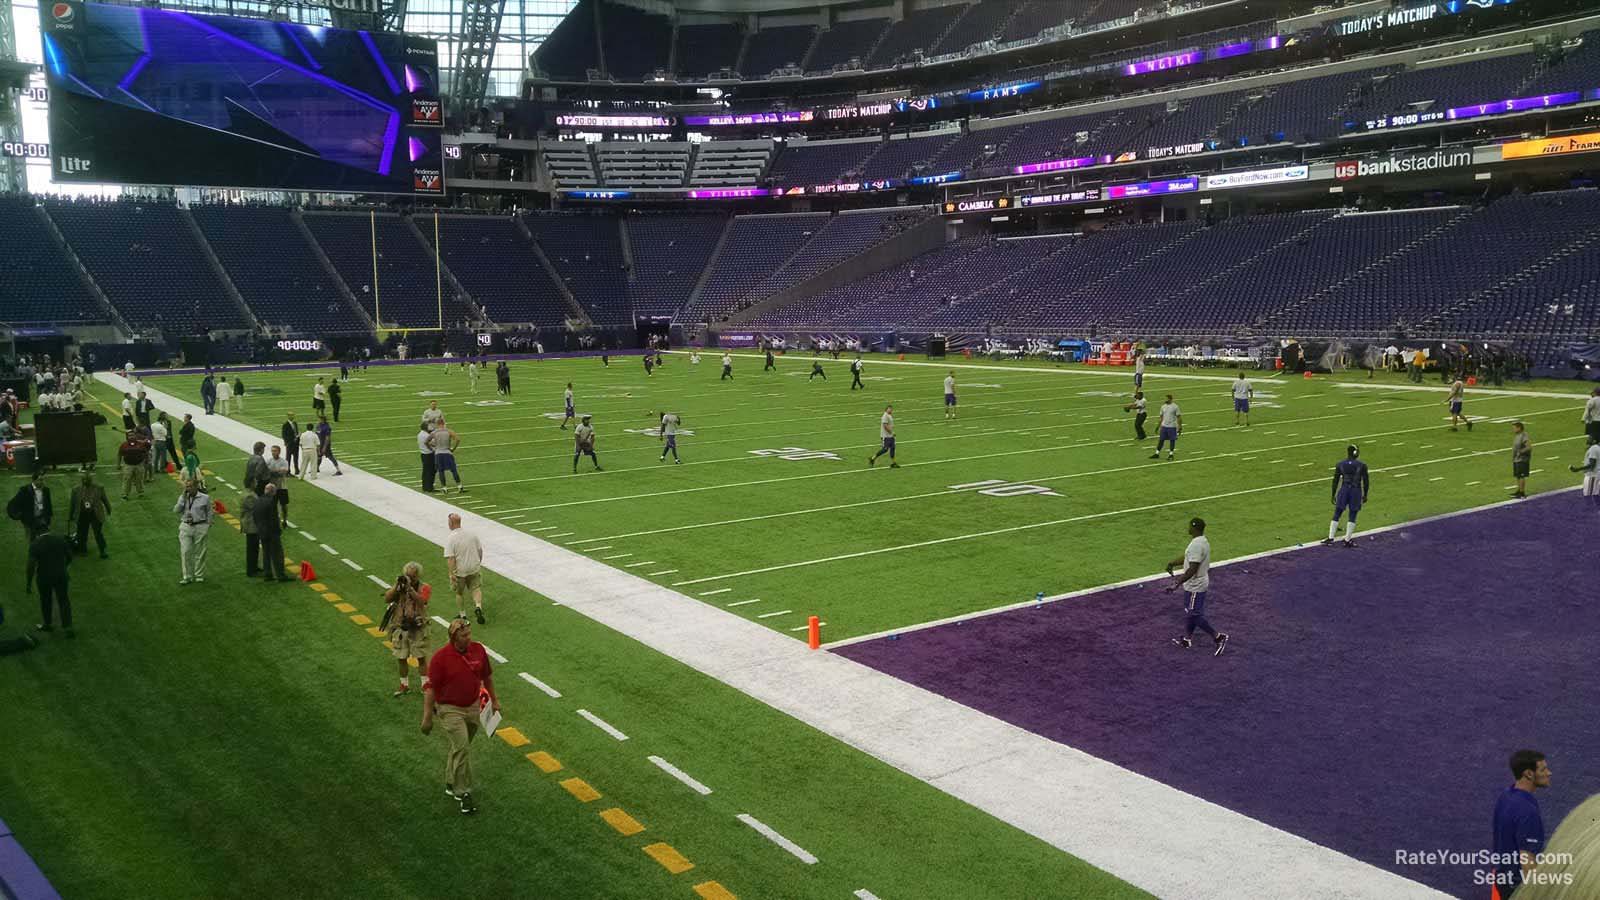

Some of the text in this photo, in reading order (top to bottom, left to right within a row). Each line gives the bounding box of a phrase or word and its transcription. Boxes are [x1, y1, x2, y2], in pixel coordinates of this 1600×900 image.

[1341, 4, 1437, 35] TODAY'S MATCHUP
[984, 87, 1018, 99] RAMS
[828, 107, 858, 119] TODAY'S
[860, 103, 892, 117] MATCHUP
[1376, 119, 1387, 128] 25
[1392, 114, 1418, 126] 90:00
[4, 142, 47, 156] 90:00
[445, 146, 460, 158] 40
[1148, 142, 1204, 158] TODAY'S MATCHUP
[60, 156, 92, 174] Lite
[1035, 159, 1080, 171] VIKINGS
[1228, 171, 1284, 184] BuyFordNow.com
[585, 191, 614, 199] RAMS
[958, 200, 994, 212] CAMBRIA
[478, 334, 490, 345] 40
